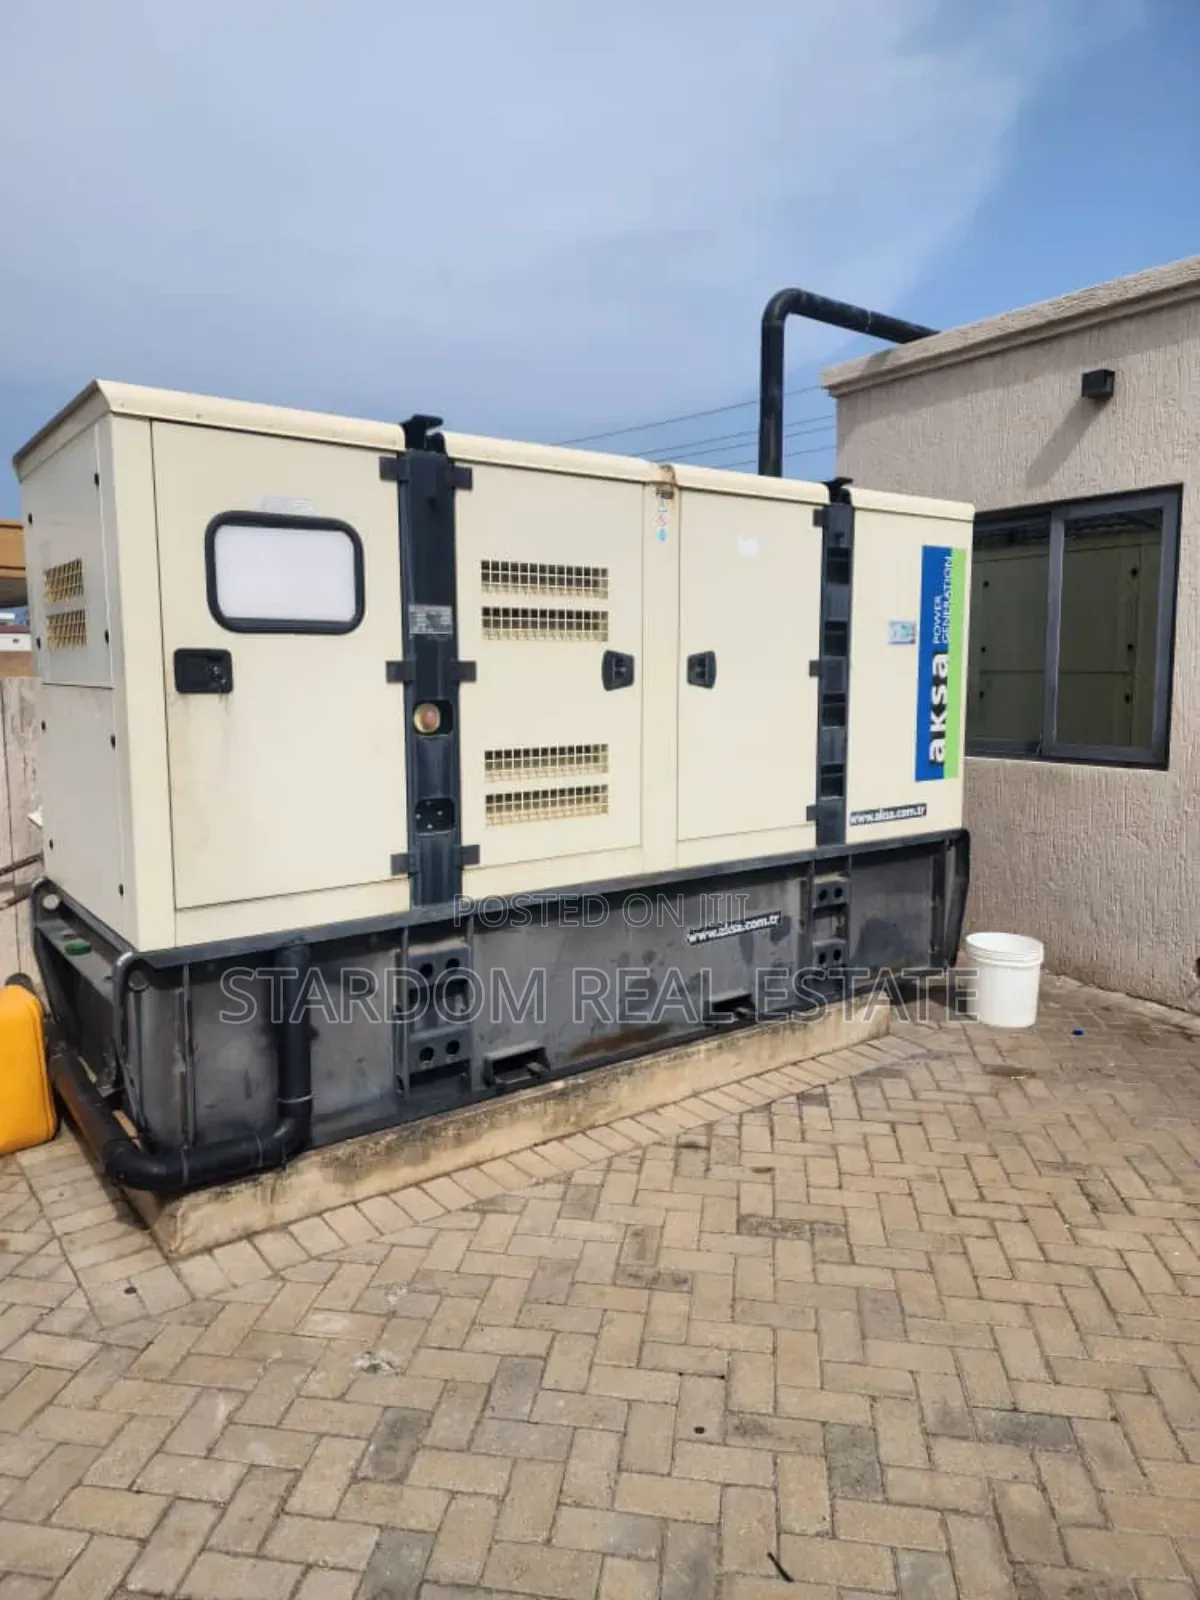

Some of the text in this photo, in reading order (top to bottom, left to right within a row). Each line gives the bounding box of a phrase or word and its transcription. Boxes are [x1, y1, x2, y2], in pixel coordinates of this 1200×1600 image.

[932, 595, 942, 644] POWER
[941, 556, 953, 644] GENERATION
[928, 653, 949, 763] aksa
